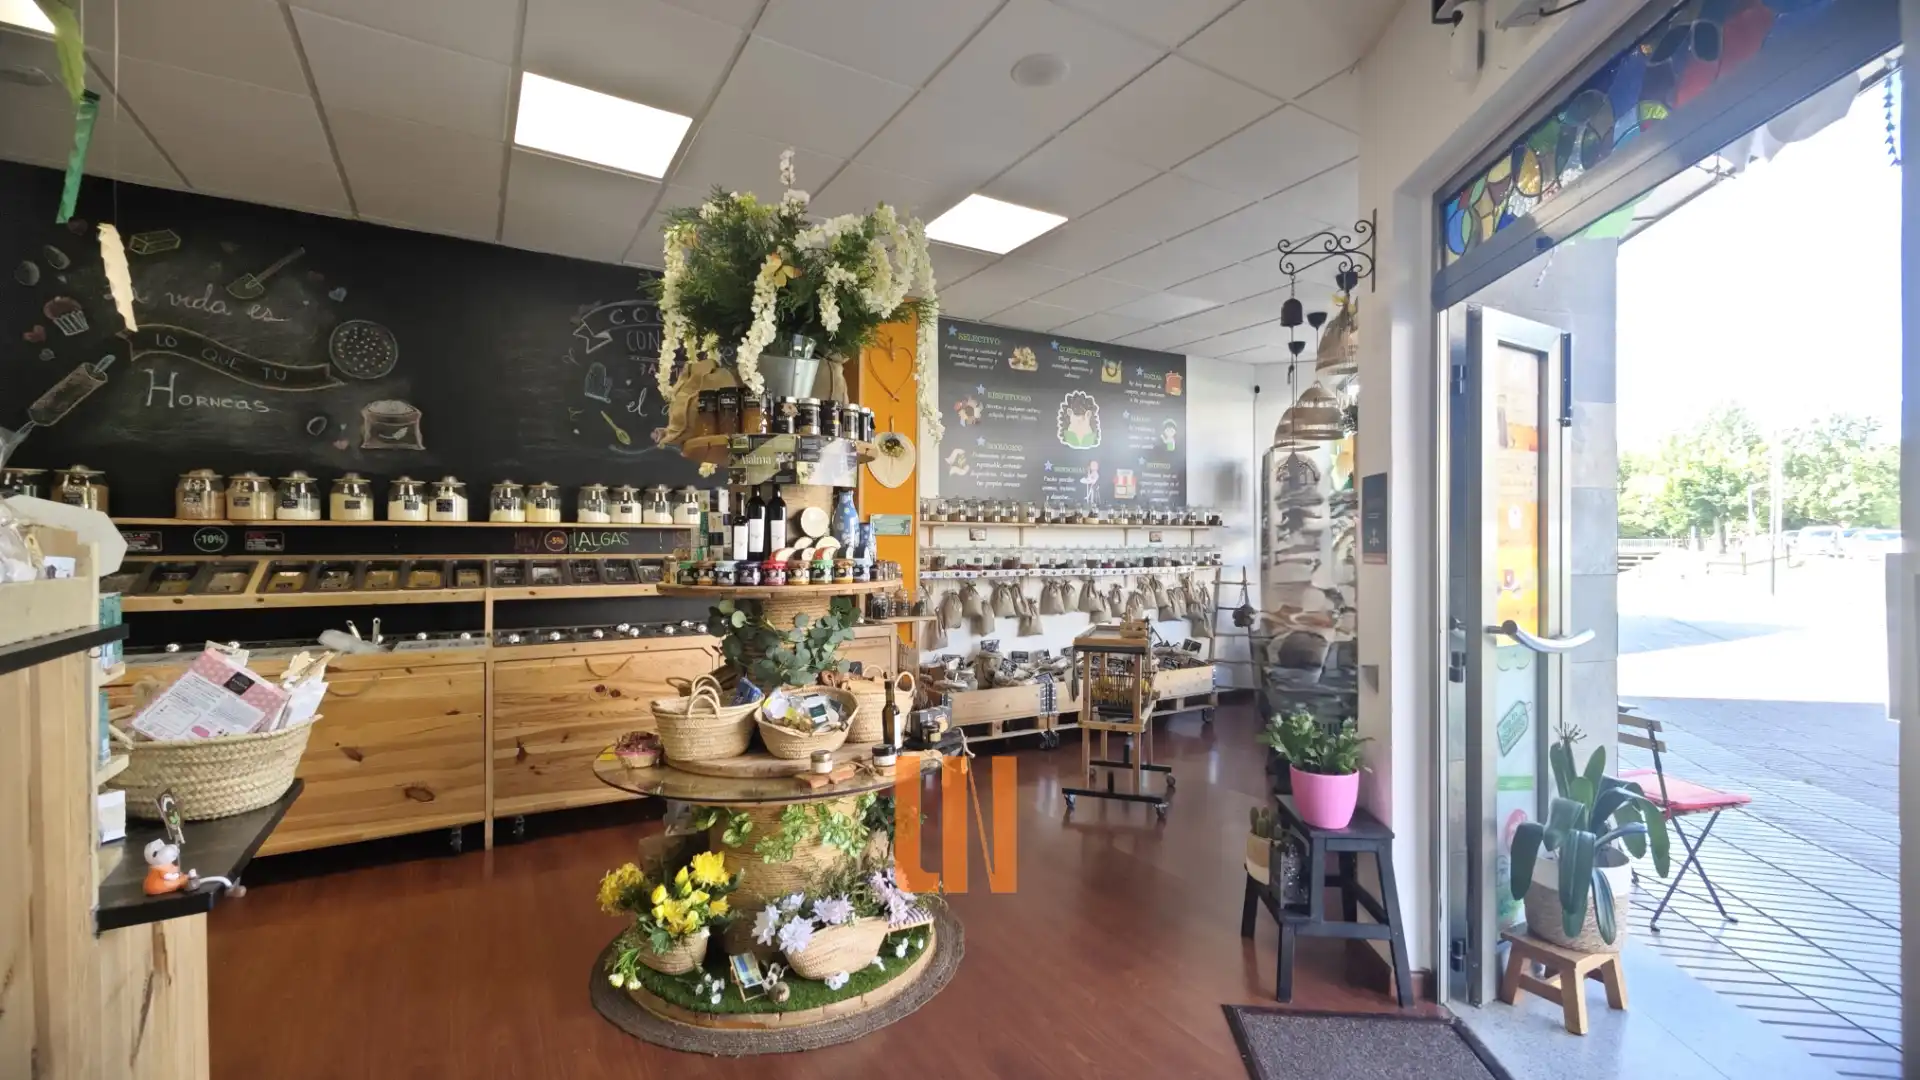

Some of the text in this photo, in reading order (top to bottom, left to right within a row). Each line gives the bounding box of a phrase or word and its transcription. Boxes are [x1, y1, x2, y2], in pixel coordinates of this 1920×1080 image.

[165, 283, 233, 316] vida
[247, 303, 291, 322] es
[156, 333, 287, 381] LO QUE TU
[626, 388, 648, 417] el
[196, 534, 224, 545] -10%
